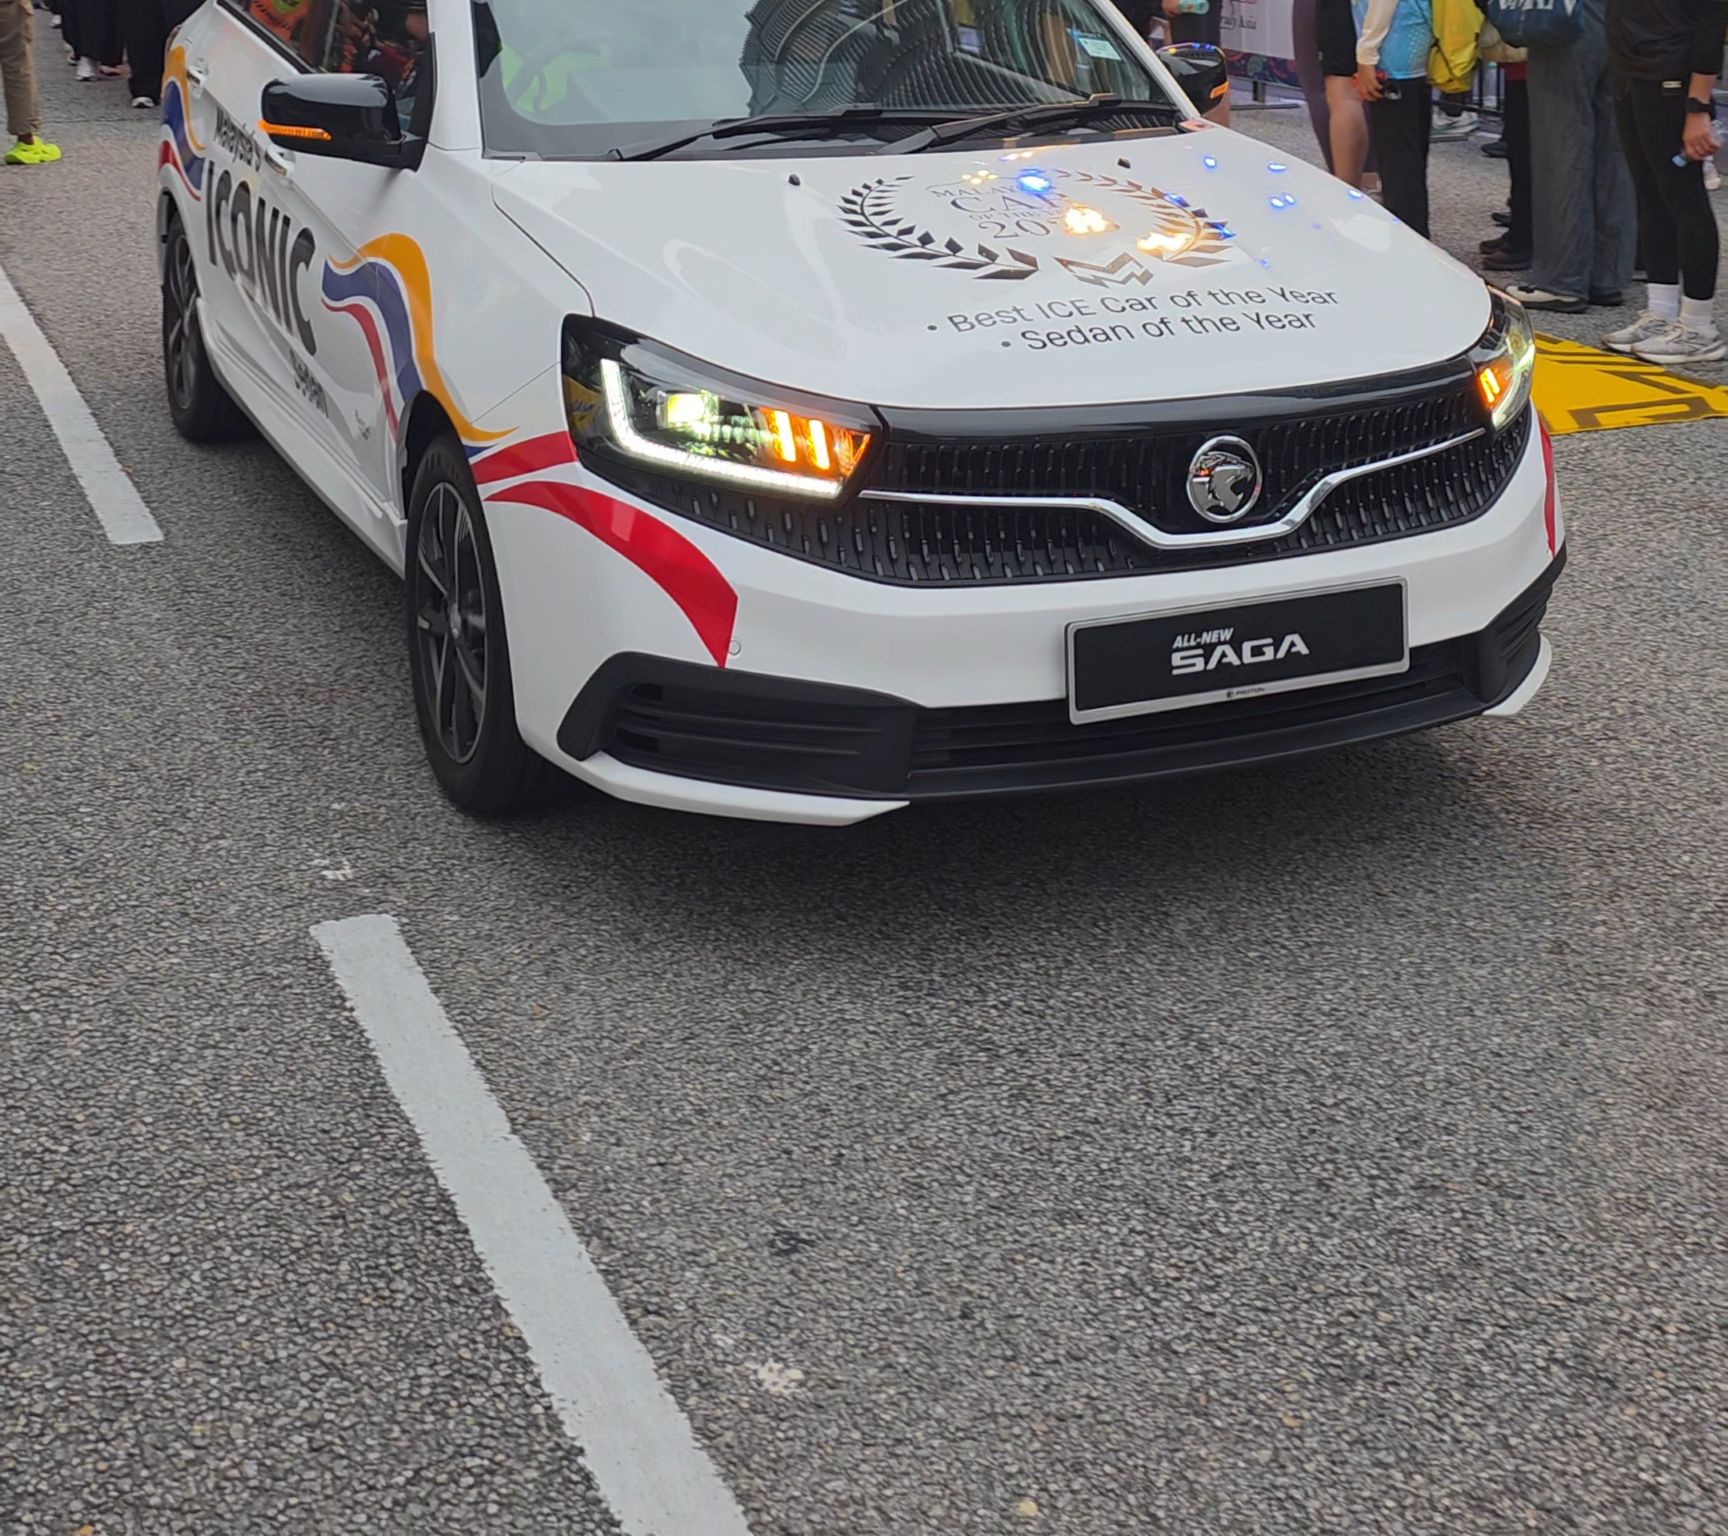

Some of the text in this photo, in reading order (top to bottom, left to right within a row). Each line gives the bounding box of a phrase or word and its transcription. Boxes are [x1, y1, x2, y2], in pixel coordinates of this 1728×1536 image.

[206, 160, 317, 356] ICONIC
[947, 286, 1339, 333] Best ICE Car of the Year
[1020, 311, 1317, 350] Sedan of the Year
[1171, 633, 1310, 675] SAGA
[1172, 627, 1234, 649] ALL-NEW
